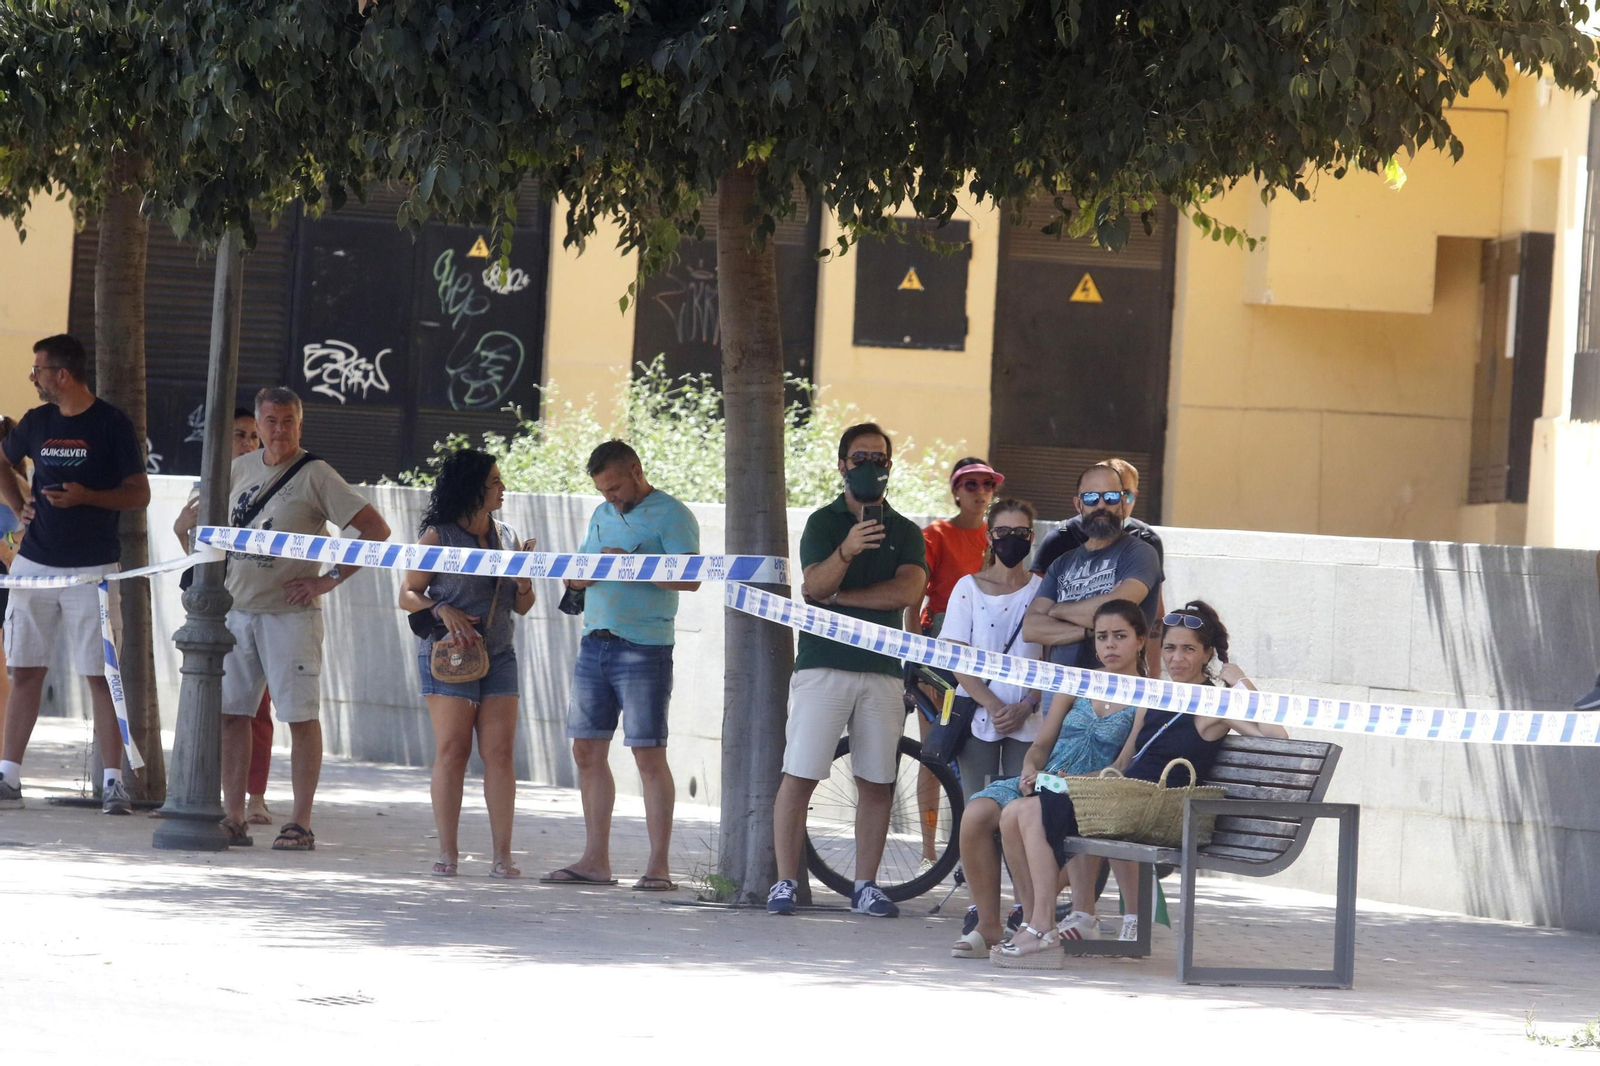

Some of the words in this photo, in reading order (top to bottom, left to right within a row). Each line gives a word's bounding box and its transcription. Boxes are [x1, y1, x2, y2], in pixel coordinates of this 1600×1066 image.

[40, 448, 87, 457] QUIKSILVER
[290, 547, 304, 558] POLICIA
[368, 543, 381, 553] LOCAL
[365, 554, 379, 566] POLICIA
[447, 549, 461, 560] LOCAL
[533, 553, 547, 565] LOCAL
[443, 561, 460, 572] POLICIA
[576, 555, 589, 567] PASAR
[621, 556, 635, 567] LOCAL
[664, 556, 678, 568] PASAR
[709, 556, 724, 568] LOCAL
[529, 565, 546, 577] POLICIA
[577, 568, 584, 578] NO
[618, 568, 635, 580] POLICIA
[666, 569, 674, 580] NO
[706, 569, 725, 580] POLICIA
[111, 674, 123, 703] POLICIA
